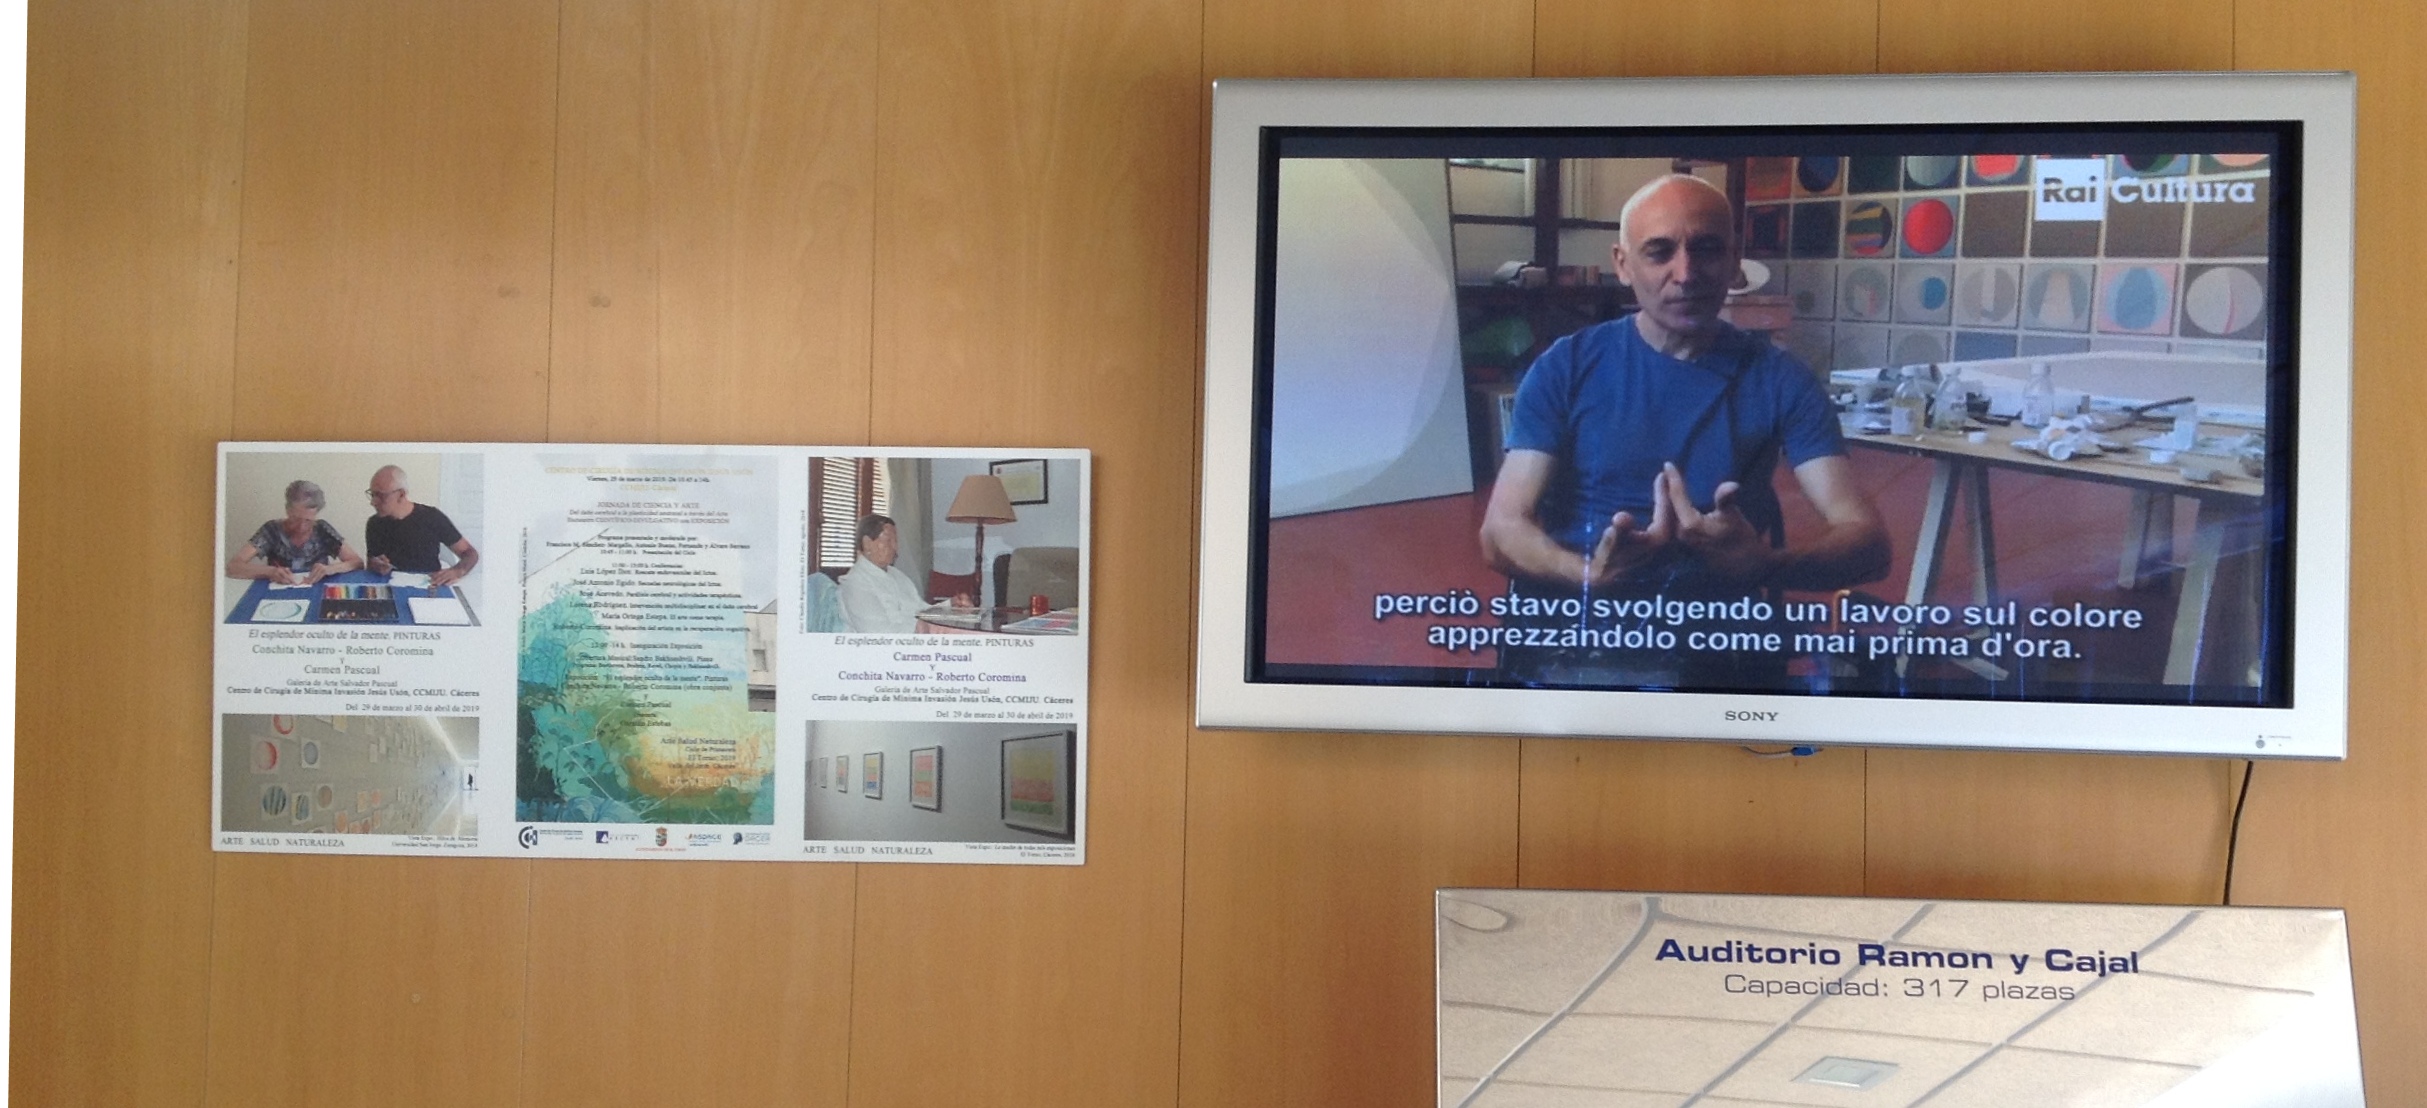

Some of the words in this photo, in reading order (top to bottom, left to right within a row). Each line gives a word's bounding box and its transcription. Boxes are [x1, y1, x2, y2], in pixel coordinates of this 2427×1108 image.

[2043, 175, 2098, 203] Rai
[2110, 176, 2256, 204] Cultura
[1374, 593, 1479, 622] perciò
[1490, 596, 1582, 618] stavo
[1592, 597, 1769, 624] svolgendo
[1785, 602, 1828, 622] un
[1840, 599, 1952, 625] lavoro
[1963, 600, 2016, 626] sul
[2030, 602, 2143, 629] colore
[248, 629, 260, 638] El
[260, 630, 304, 640] esplendor
[306, 630, 334, 640] oculto
[336, 630, 348, 640] de
[350, 630, 358, 640] la
[393, 632, 442, 640] PINTURAS
[834, 636, 846, 645] El
[847, 636, 894, 648] esplendor
[895, 637, 924, 646] oculto
[926, 637, 938, 646] de
[941, 637, 950, 646] la
[952, 638, 982, 646] mente.
[985, 638, 1034, 648] PINTURAS
[1688, 630, 1782, 653] come
[1793, 629, 1857, 654] mai
[1868, 631, 1968, 660] prima
[1980, 632, 2082, 660] d'ora.
[252, 644, 294, 654] Conchita
[297, 646, 336, 655] Navarro
[346, 646, 384, 656] Roberto
[386, 646, 434, 656] Coromina
[892, 652, 932, 662] Carmen
[935, 652, 972, 662] Pascual
[304, 664, 341, 674] Carmen
[344, 665, 381, 675] Pascual
[838, 670, 882, 681] Conchita
[886, 672, 926, 681] Navarro
[936, 672, 975, 682] Roberto
[978, 672, 1026, 682] Coromina
[226, 686, 251, 694] Centro
[253, 686, 262, 694] de
[902, 686, 910, 694] de
[840, 694, 848, 702] de
[881, 694, 890, 702] de
[372, 704, 380, 712] de
[405, 704, 412, 712] al
[424, 704, 432, 712] de
[434, 704, 450, 712] abril
[936, 710, 949, 718] Del
[997, 711, 1004, 719] al
[1016, 712, 1025, 720] de
[1027, 712, 1044, 720] abril
[1045, 712, 1054, 720] de
[1056, 712, 1074, 720] 2019
[1725, 710, 1779, 722] SONY
[220, 837, 244, 845] ARTE
[250, 838, 280, 846] SALUD
[286, 838, 345, 847] NATURALEZA
[803, 846, 827, 854] ARTE
[834, 846, 865, 854] SALUD
[872, 846, 933, 856] NATURALEZA
[1655, 938, 1841, 967] Auditorio
[1857, 943, 1994, 970] Ramon
[2009, 952, 2030, 975] y
[2045, 948, 2140, 977] Cajal
[1723, 973, 1889, 998] Capacidad:
[1903, 978, 1969, 999] 317
[1982, 980, 2076, 1003] plazas
